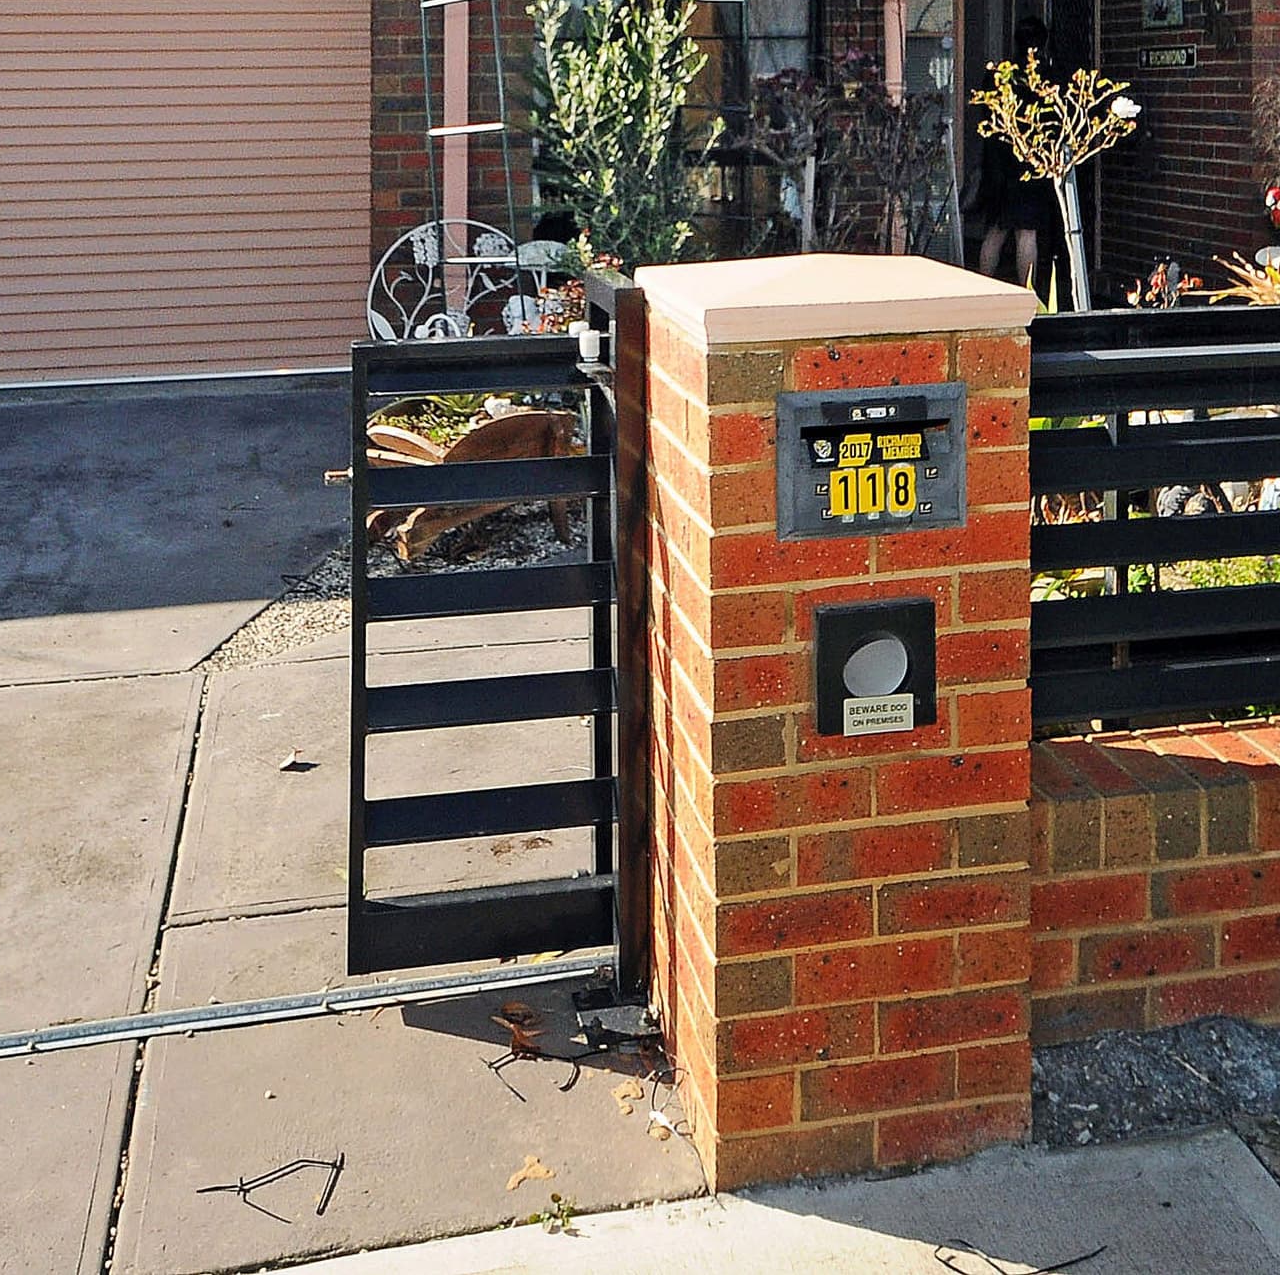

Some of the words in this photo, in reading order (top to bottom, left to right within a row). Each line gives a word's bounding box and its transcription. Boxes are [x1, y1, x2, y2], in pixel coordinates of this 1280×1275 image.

[877, 434, 922, 448] RICHMOND
[841, 443, 871, 459] 2017
[883, 446, 921, 459] MEMBER
[838, 471, 909, 510] 118
[849, 704, 888, 715] BEWARE
[890, 703, 908, 712] DOG
[852, 719, 864, 727] ON
[866, 716, 904, 725] PREMISES
